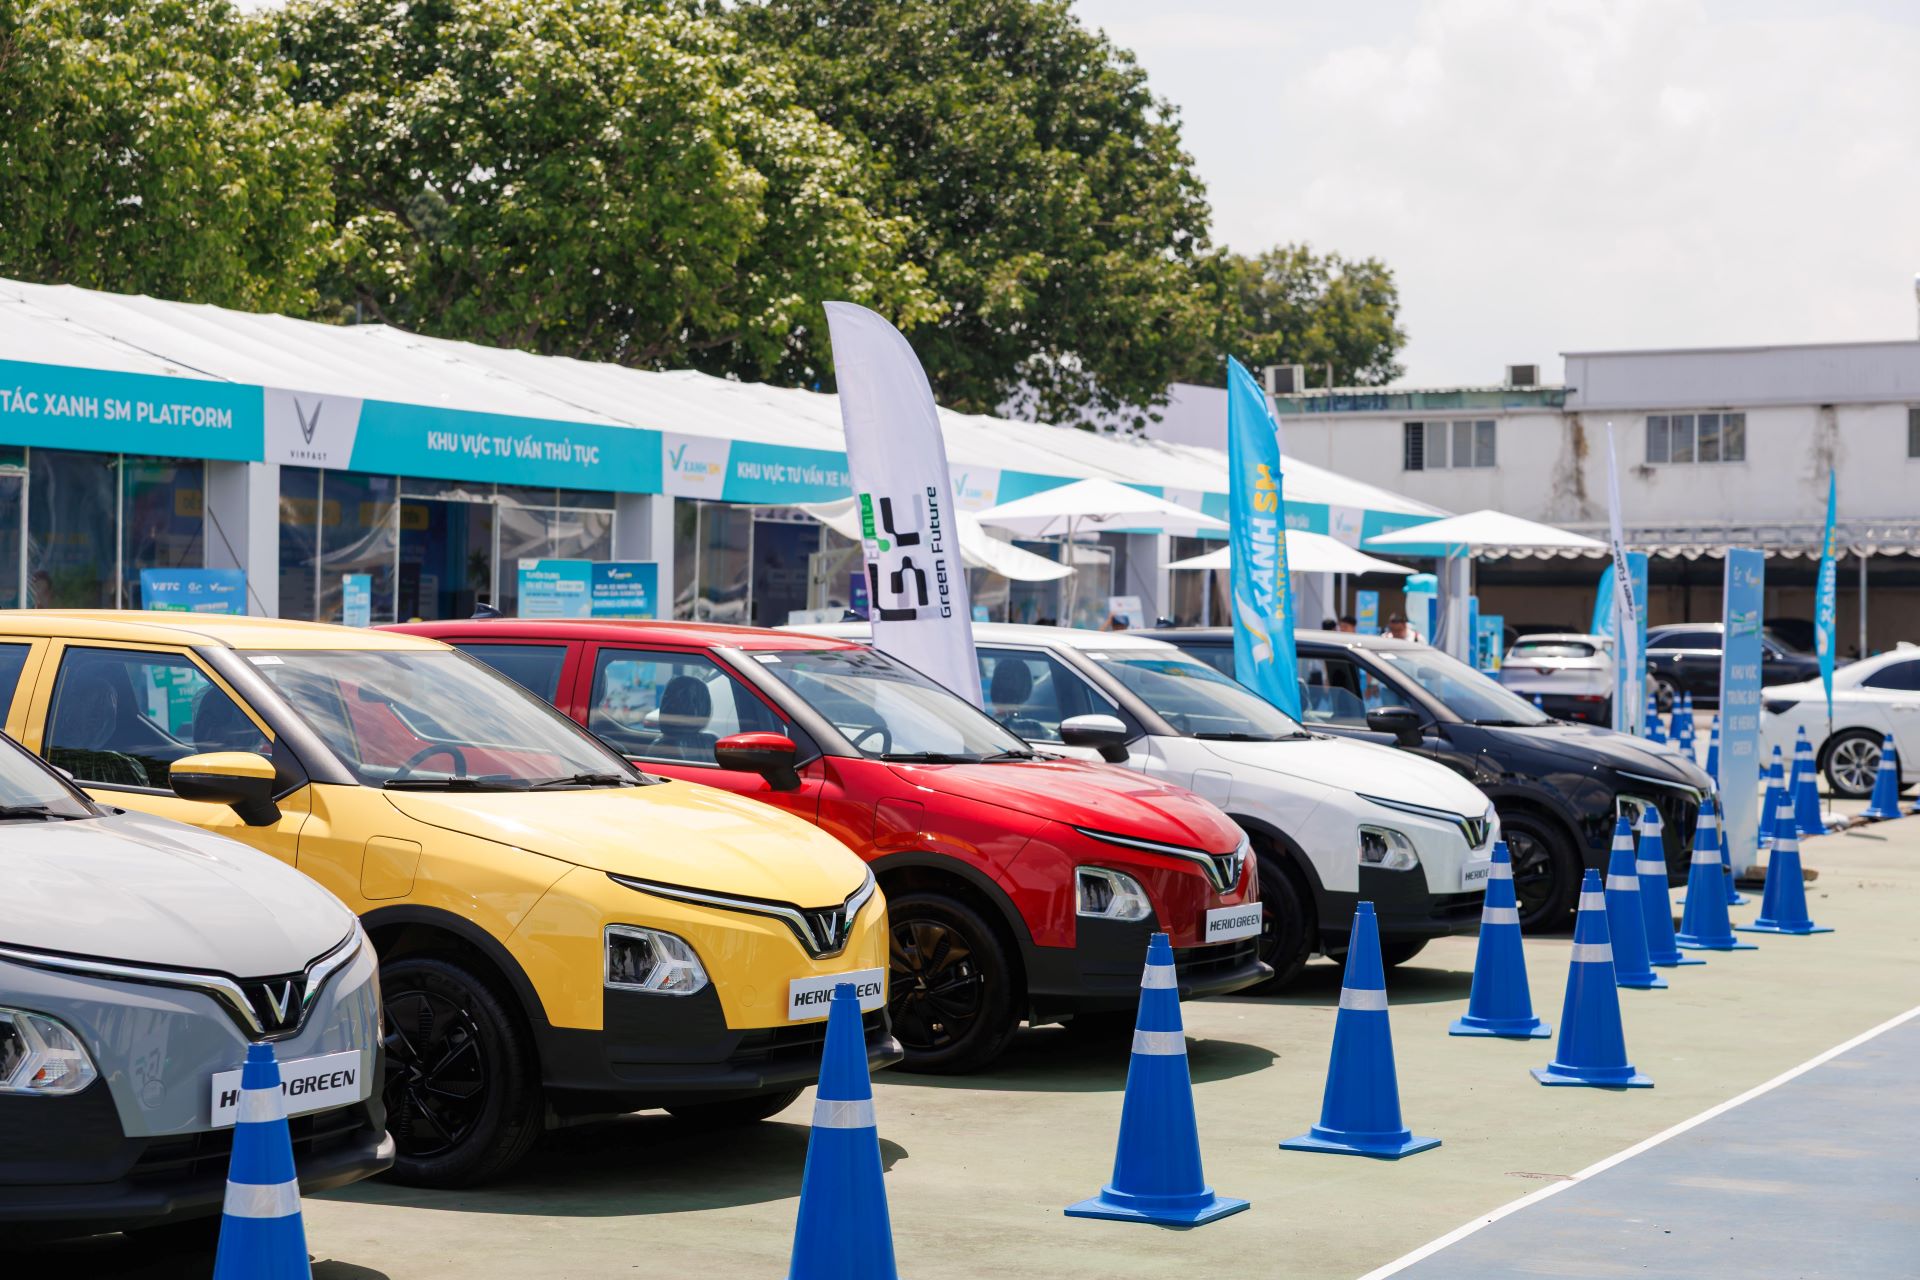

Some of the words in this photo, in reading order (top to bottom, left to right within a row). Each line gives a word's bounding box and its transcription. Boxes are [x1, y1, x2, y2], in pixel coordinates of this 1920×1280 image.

[0, 386, 39, 414] TÁC
[43, 393, 99, 418] XANH
[104, 399, 131, 421] SM
[136, 402, 233, 429] PLATFORM
[290, 449, 327, 461] VINFAST
[427, 431, 458, 452] KHU
[461, 433, 491, 459] VỰC
[493, 435, 513, 457] TƯ
[514, 434, 542, 460] VẤN
[544, 437, 571, 462] THỦ
[574, 444, 600, 468] TỤC
[737, 461, 761, 480] KHU
[763, 463, 785, 485] VỰC
[1254, 464, 1277, 513] SM
[926, 487, 944, 553] Future
[1252, 518, 1277, 618] XANH
[935, 560, 951, 618] Green
[1210, 917, 1236, 931] HERIO
[1236, 914, 1260, 928] GREEN
[289, 1069, 355, 1096] GREEN
